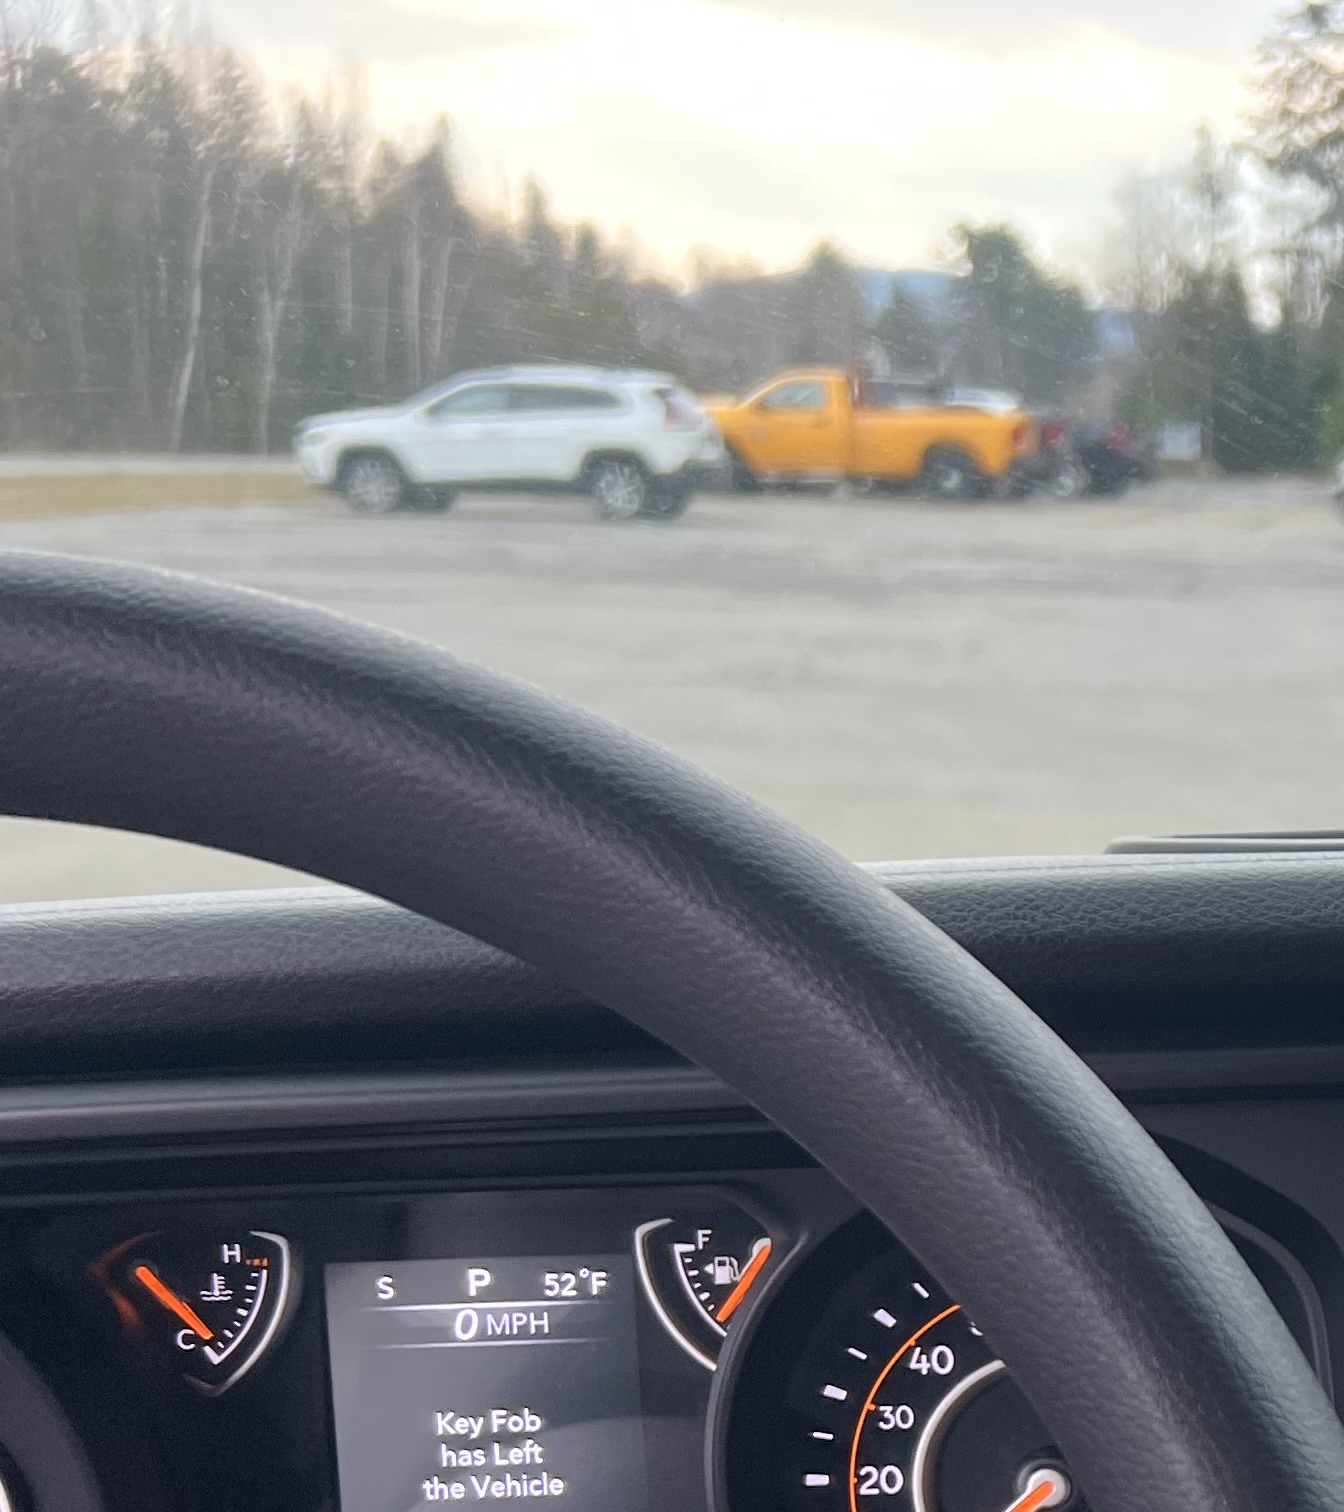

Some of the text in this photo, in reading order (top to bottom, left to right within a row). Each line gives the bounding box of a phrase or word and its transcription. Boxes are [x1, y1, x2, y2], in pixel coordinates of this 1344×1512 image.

[222, 1243, 241, 1264] H
[697, 1229, 713, 1251] F
[376, 1267, 608, 1299] S P 52°F
[455, 1308, 550, 1341] 0 MPH
[177, 1328, 197, 1351] C
[909, 1345, 955, 1375] 40
[434, 1408, 543, 1438] Key Fob
[878, 1405, 915, 1430] 30
[440, 1439, 544, 1467] has Left
[422, 1472, 565, 1500] the Vehicle
[859, 1465, 904, 1495] 20
